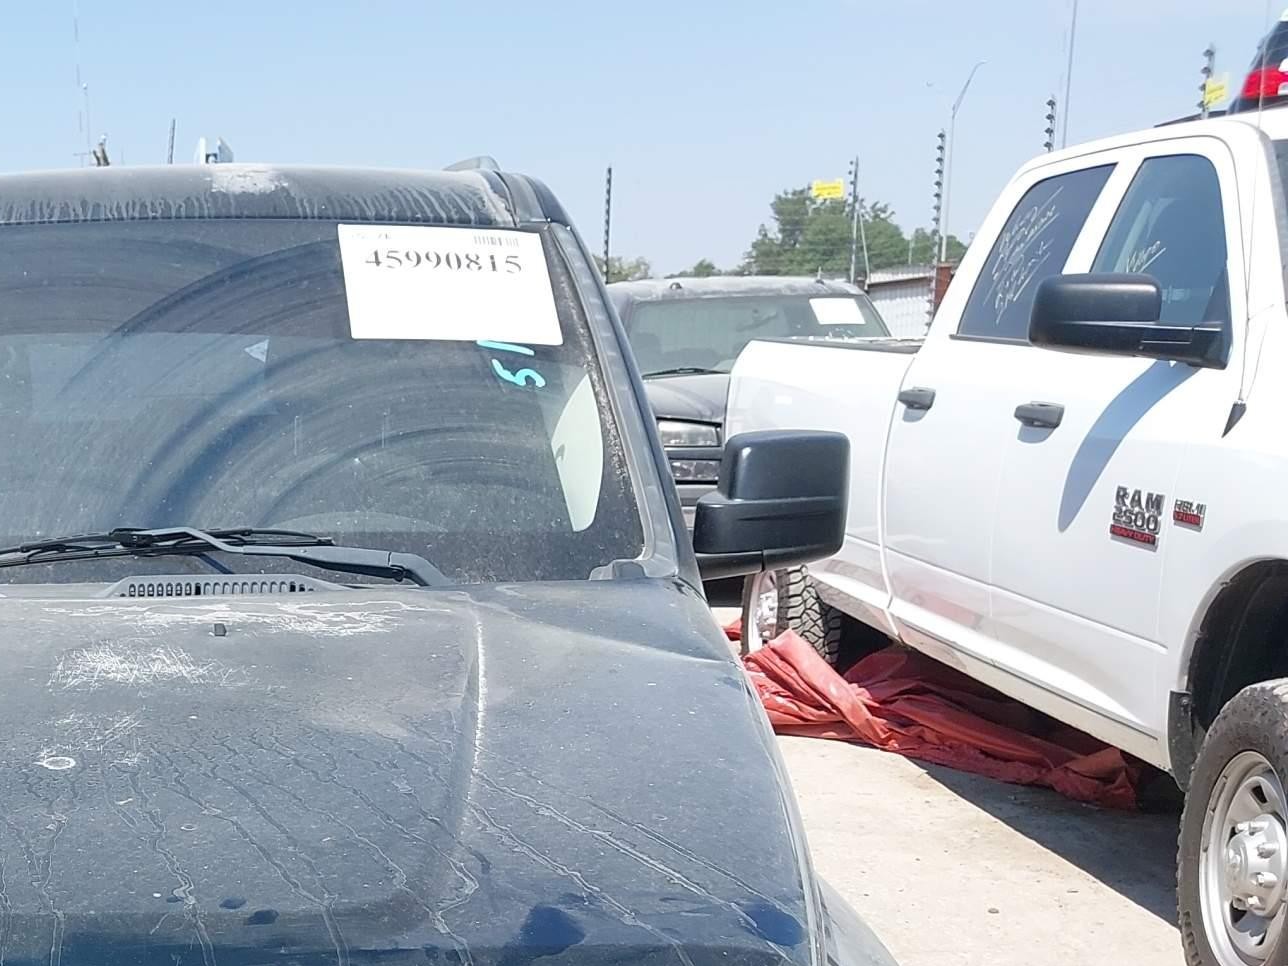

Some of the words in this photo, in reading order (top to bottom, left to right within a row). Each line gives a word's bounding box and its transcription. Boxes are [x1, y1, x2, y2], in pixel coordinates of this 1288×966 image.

[364, 246, 523, 274] 45990815
[1115, 485, 1166, 517] RAM
[1112, 504, 1161, 536] 2500
